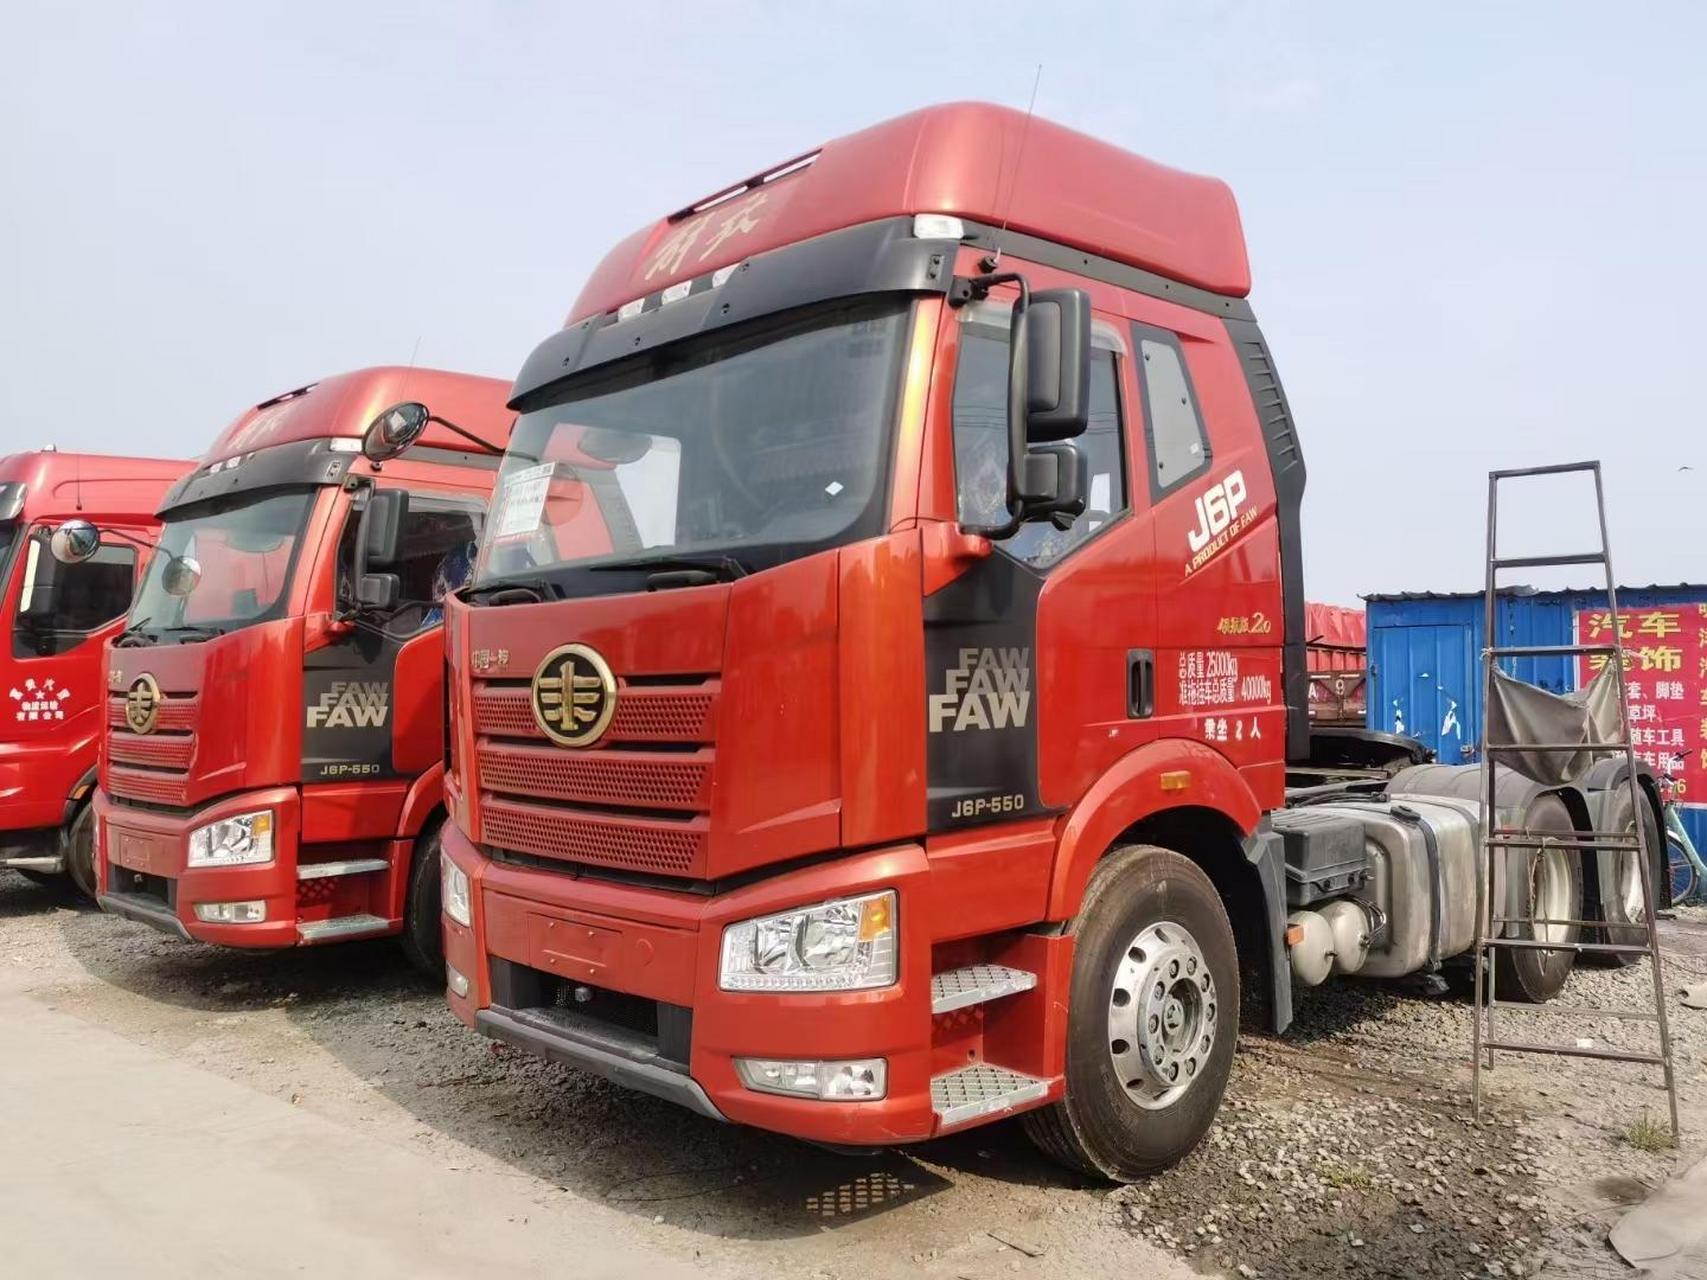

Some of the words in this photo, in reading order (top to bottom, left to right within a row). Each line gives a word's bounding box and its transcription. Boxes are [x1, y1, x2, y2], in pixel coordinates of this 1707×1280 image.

[1188, 470, 1247, 552] J6P
[1192, 530, 1230, 569] PRODUCT
[1588, 611, 1681, 639] 汽车
[958, 647, 1029, 671] FAW
[1178, 651, 1205, 679] 总质量
[331, 682, 389, 694] FAW
[945, 668, 1029, 698] FAW
[1624, 681, 1684, 701] 套、脚垫
[320, 692, 389, 709] FAW
[928, 691, 1030, 733] FAW
[306, 705, 389, 728] FAW
[1235, 719, 1243, 740] 2
[1250, 716, 1261, 740] 人
[1630, 729, 1685, 747] 随车工具
[320, 764, 381, 775] J6P-550
[951, 794, 1025, 818] J6P-550
